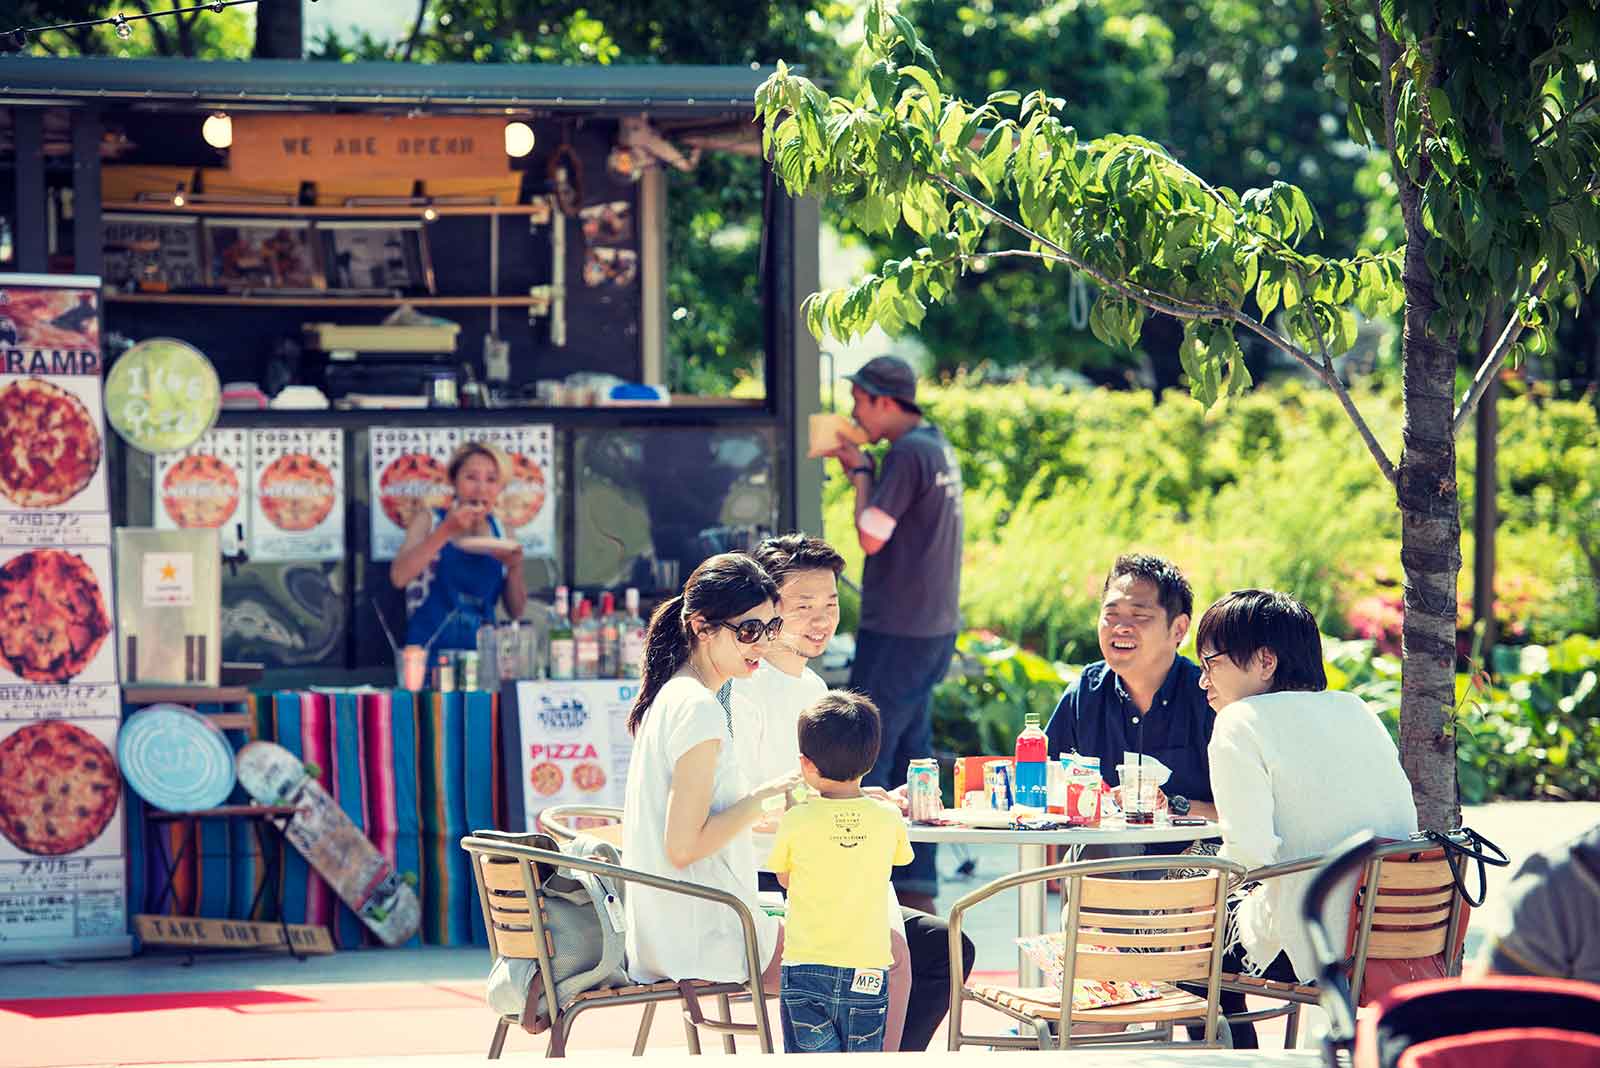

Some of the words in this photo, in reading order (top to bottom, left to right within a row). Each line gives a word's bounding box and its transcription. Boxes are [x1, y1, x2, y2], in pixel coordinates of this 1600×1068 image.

[283, 137, 311, 155] WE
[334, 137, 376, 155] ARE
[531, 743, 598, 759] PIZZA
[856, 975, 881, 988] MPS
